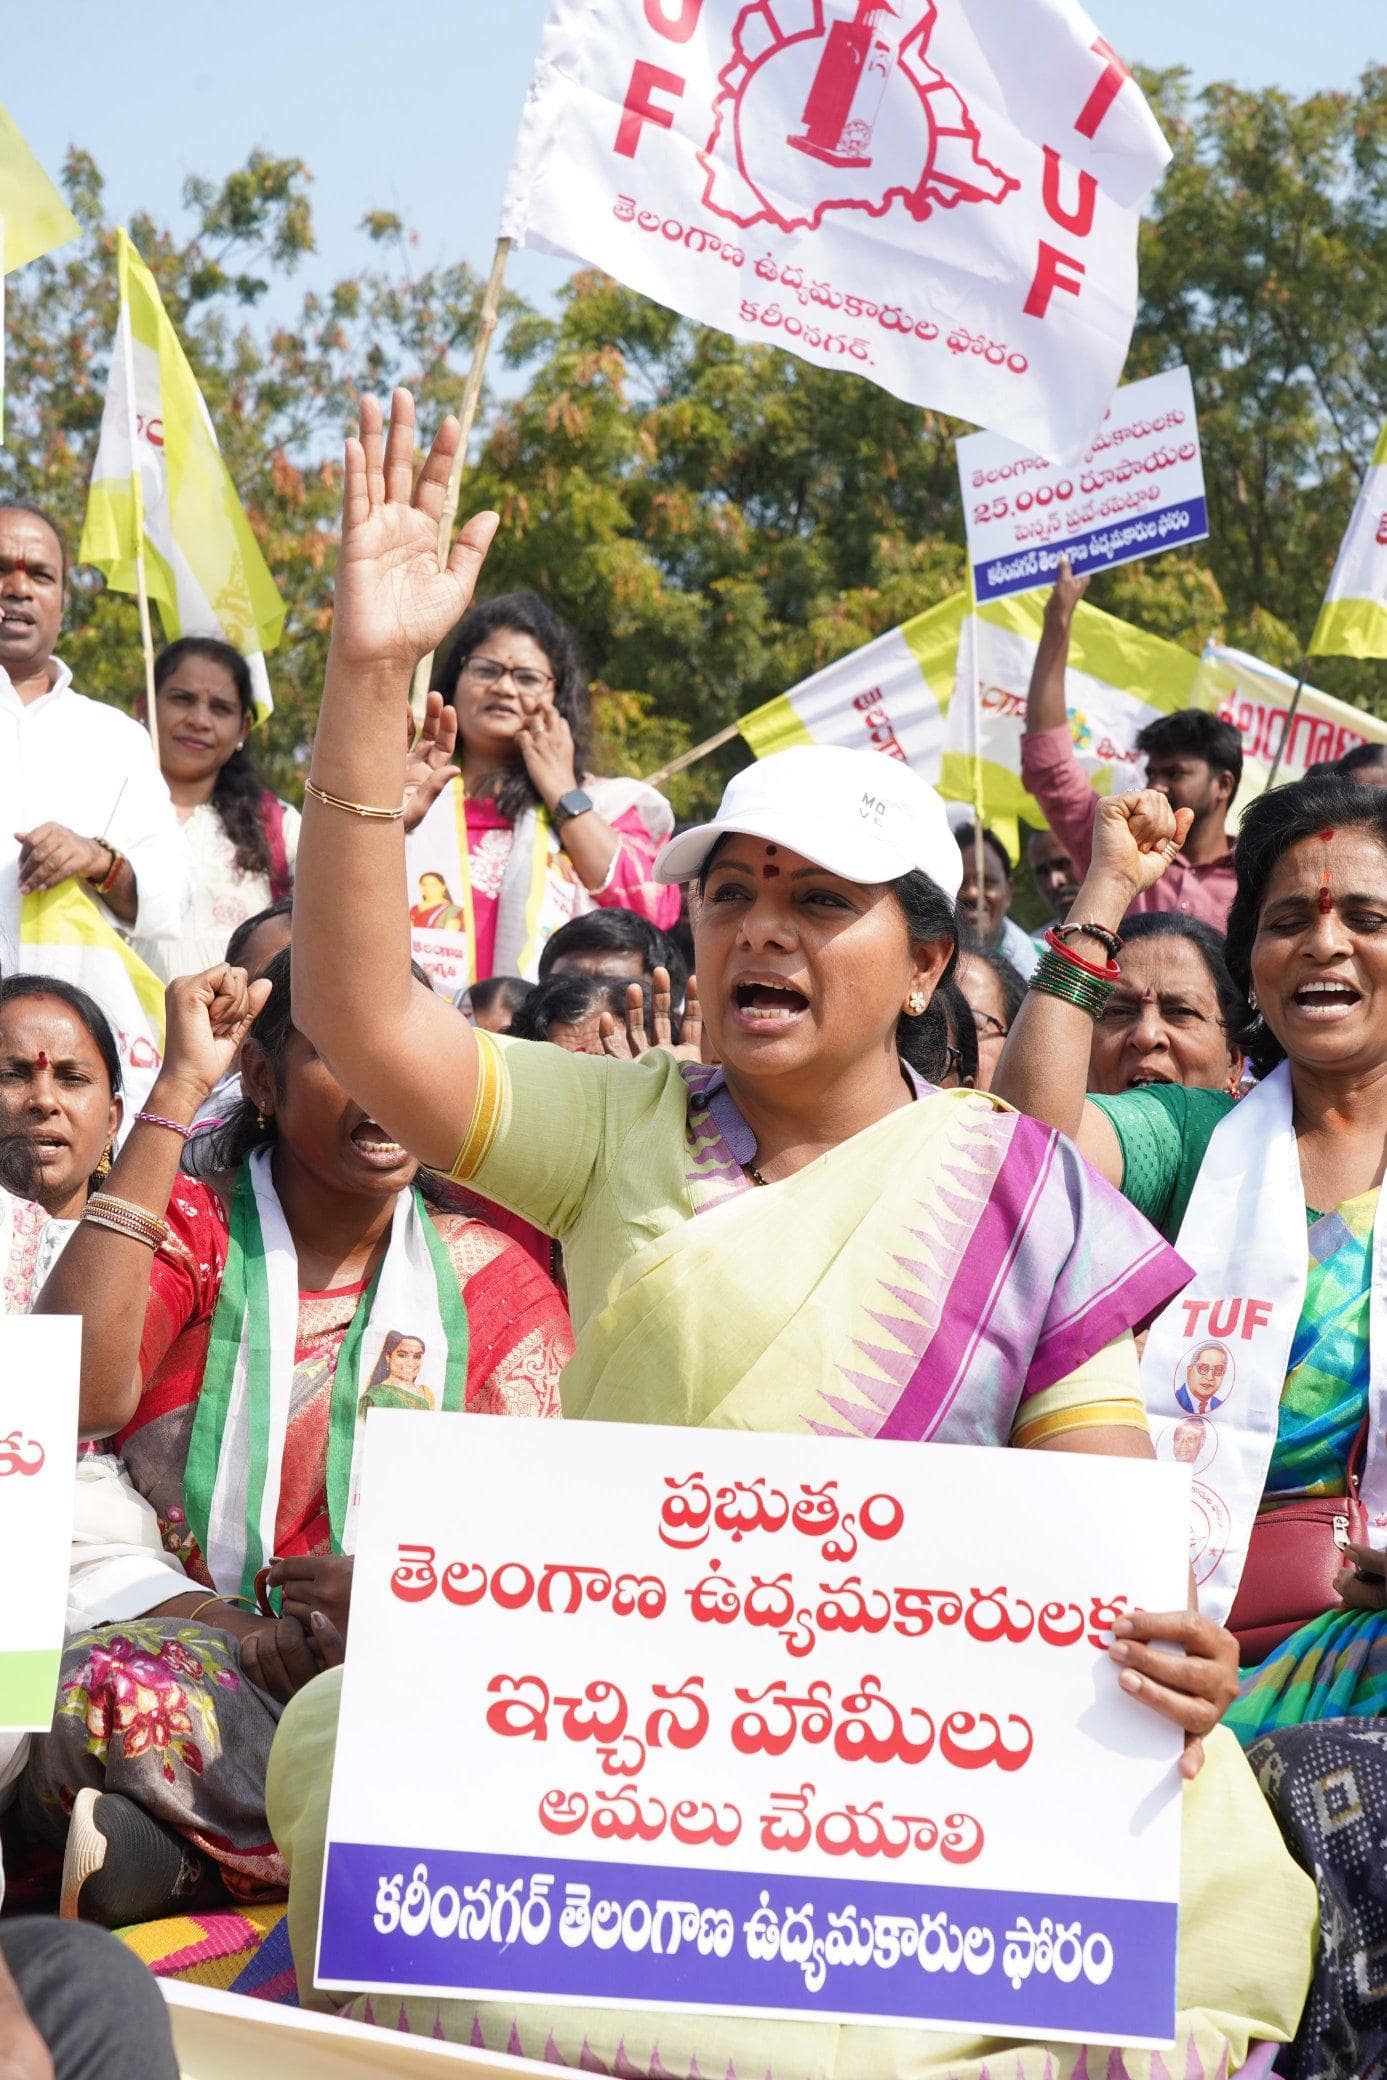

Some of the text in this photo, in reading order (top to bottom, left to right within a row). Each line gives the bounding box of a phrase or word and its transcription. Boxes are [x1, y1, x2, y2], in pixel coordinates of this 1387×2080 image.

[613, 194, 1030, 376] తెలంగాణ ఉద్యమకారుల ఫోరం
[1181, 1297, 1273, 1341] TUF
[658, 1471, 904, 1562] ప్రభుత్వం
[390, 1544, 667, 1620] తెలంగాణ
[486, 1674, 1034, 1777] ఇచ్చిన హామీలు
[538, 1782, 985, 1865] అమలు చేయాలి
[374, 1863, 1115, 1992] కరీంనగర్ తెలంగాణ ఉద్యమకారుల ఫోరం
